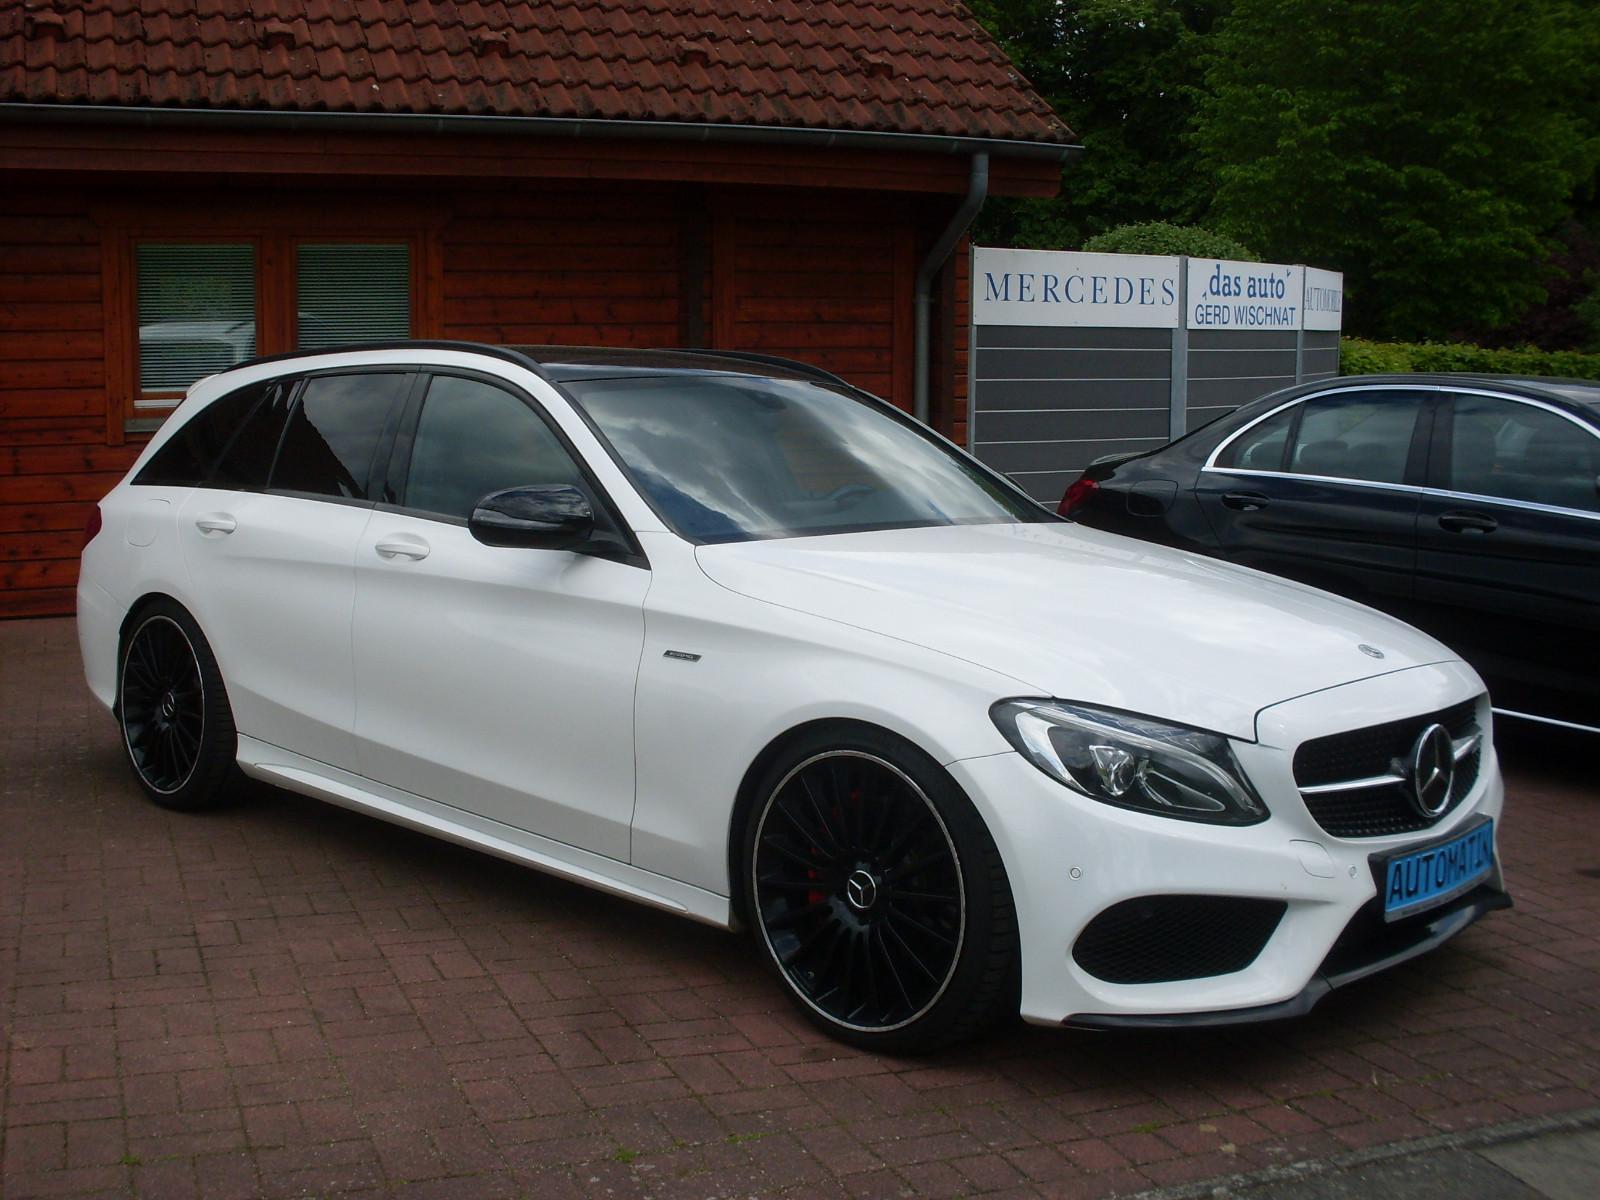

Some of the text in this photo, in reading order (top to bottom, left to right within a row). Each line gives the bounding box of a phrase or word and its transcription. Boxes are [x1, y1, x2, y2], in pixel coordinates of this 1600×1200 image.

[984, 272, 1175, 306] MERCEDES
[1195, 304, 1296, 326] GERD WISCHNAT
